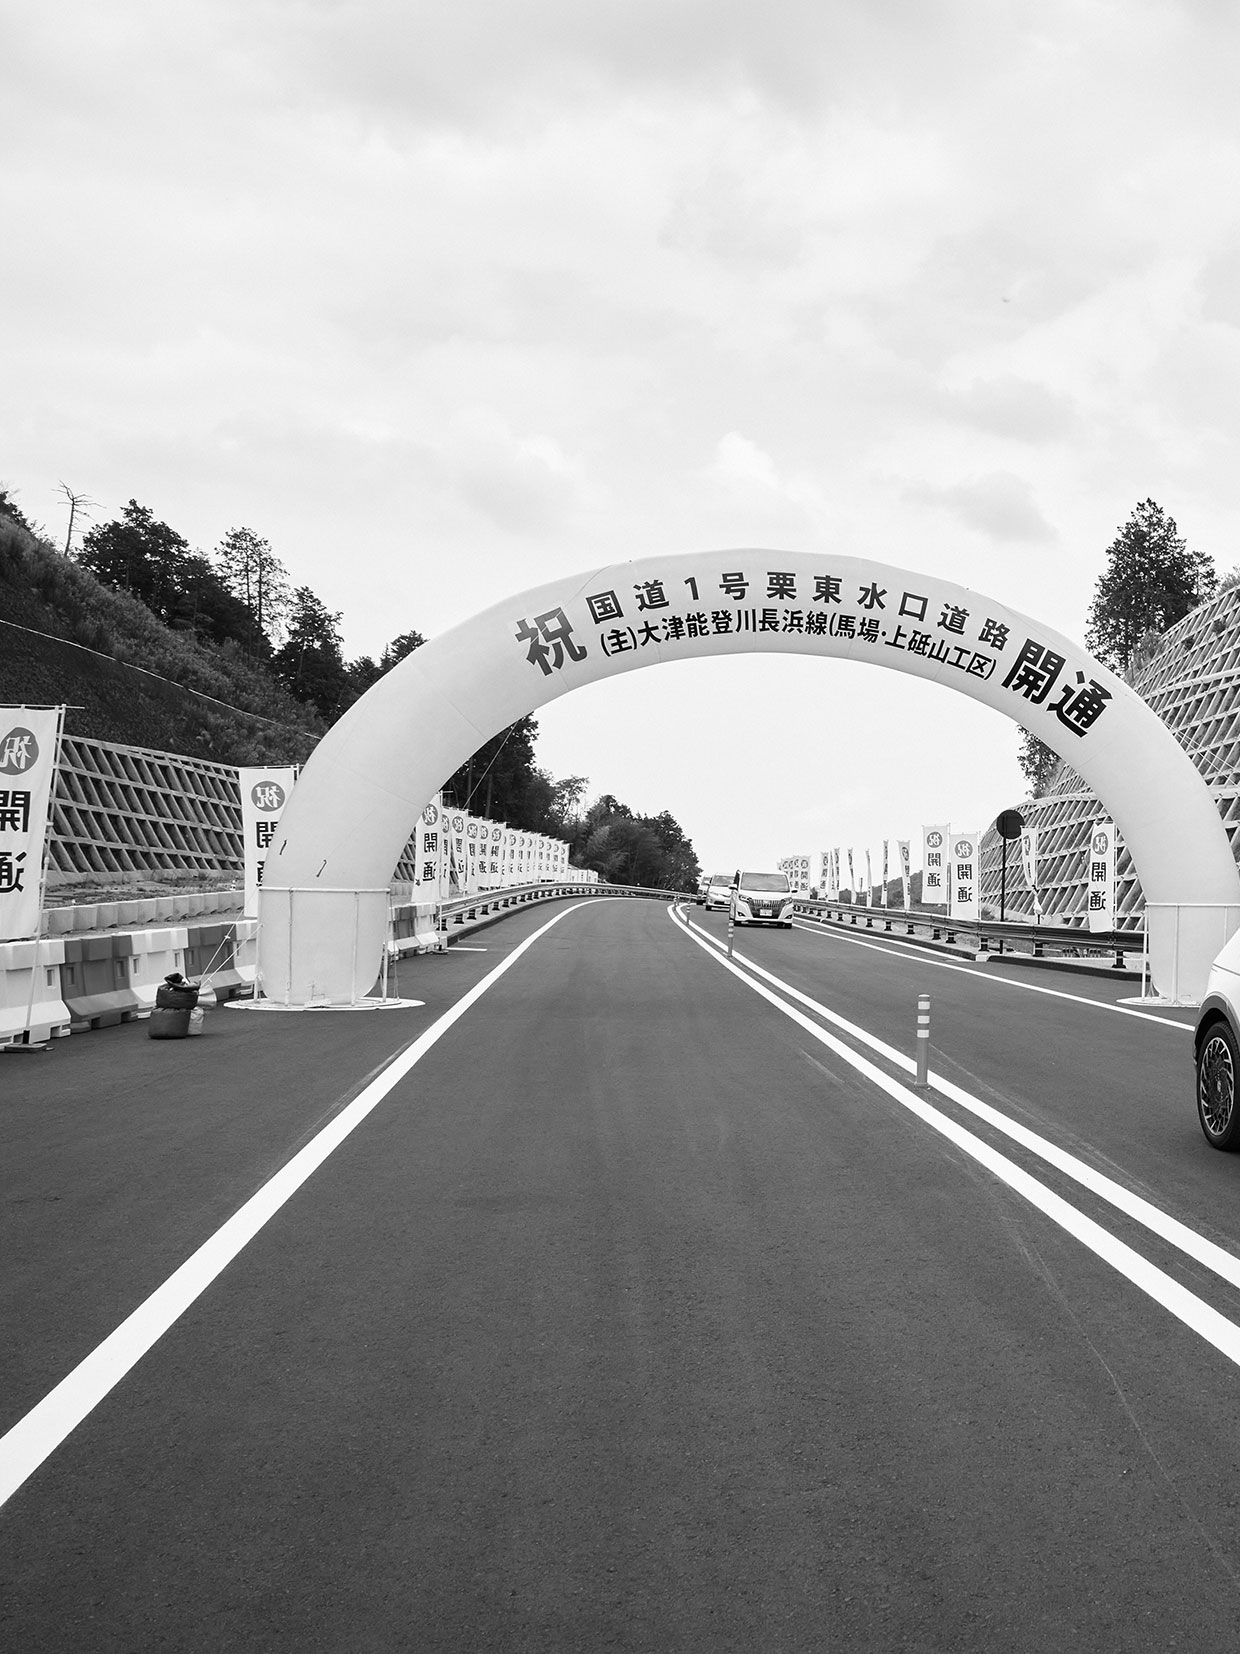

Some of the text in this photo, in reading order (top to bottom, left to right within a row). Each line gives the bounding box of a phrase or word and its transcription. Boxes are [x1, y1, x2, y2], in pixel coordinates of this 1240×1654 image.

[514, 606, 588, 676] 祝
[585, 571, 1012, 650] 国道1号栗東水口道路
[1000, 637, 1114, 738] 開通
